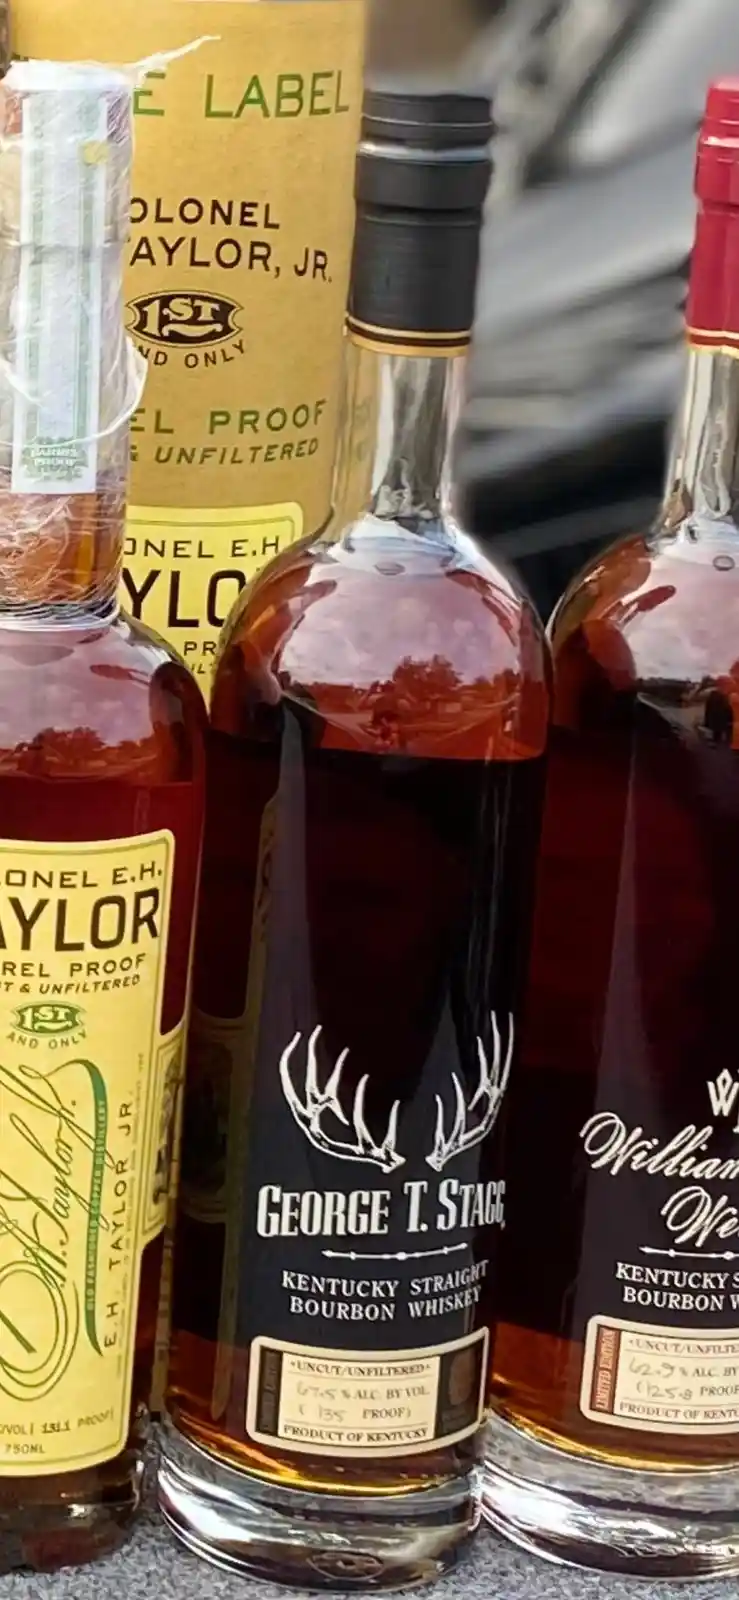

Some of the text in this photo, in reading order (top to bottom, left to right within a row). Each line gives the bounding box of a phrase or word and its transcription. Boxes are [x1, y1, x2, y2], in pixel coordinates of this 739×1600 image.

[204, 69, 350, 119] LABEL
[126, 236, 333, 283] AYLOR, JR.
[143, 298, 221, 338] 1ST
[184, 340, 247, 369] ONLY
[208, 398, 328, 435] PROOF
[154, 437, 320, 465] UNFILTERED
[0, 860, 163, 889] ONEL E.H.
[69, 952, 147, 978] PROOF
[19, 983, 32, 994] &
[39, 974, 140, 994] UNFILTERED
[21, 1005, 71, 1032] 1ST
[6, 1029, 88, 1051] AND ONLY
[108, 1158, 129, 1272] TAYLOR
[256, 1184, 391, 1238] GEORGE
[403, 1180, 429, 1233] T.
[281, 1259, 490, 1298] KENTUCKY STRAIGHT
[615, 1261, 731, 1289] KENTUCKY
[289, 1284, 482, 1322] BOURBON WHISKEY
[622, 1286, 726, 1311] BOURBON
[619, 1401, 682, 1420] PRODUCT
[683, 1408, 701, 1421] OF
[283, 1424, 429, 1442] PRODUCT OF KENTUCKY
